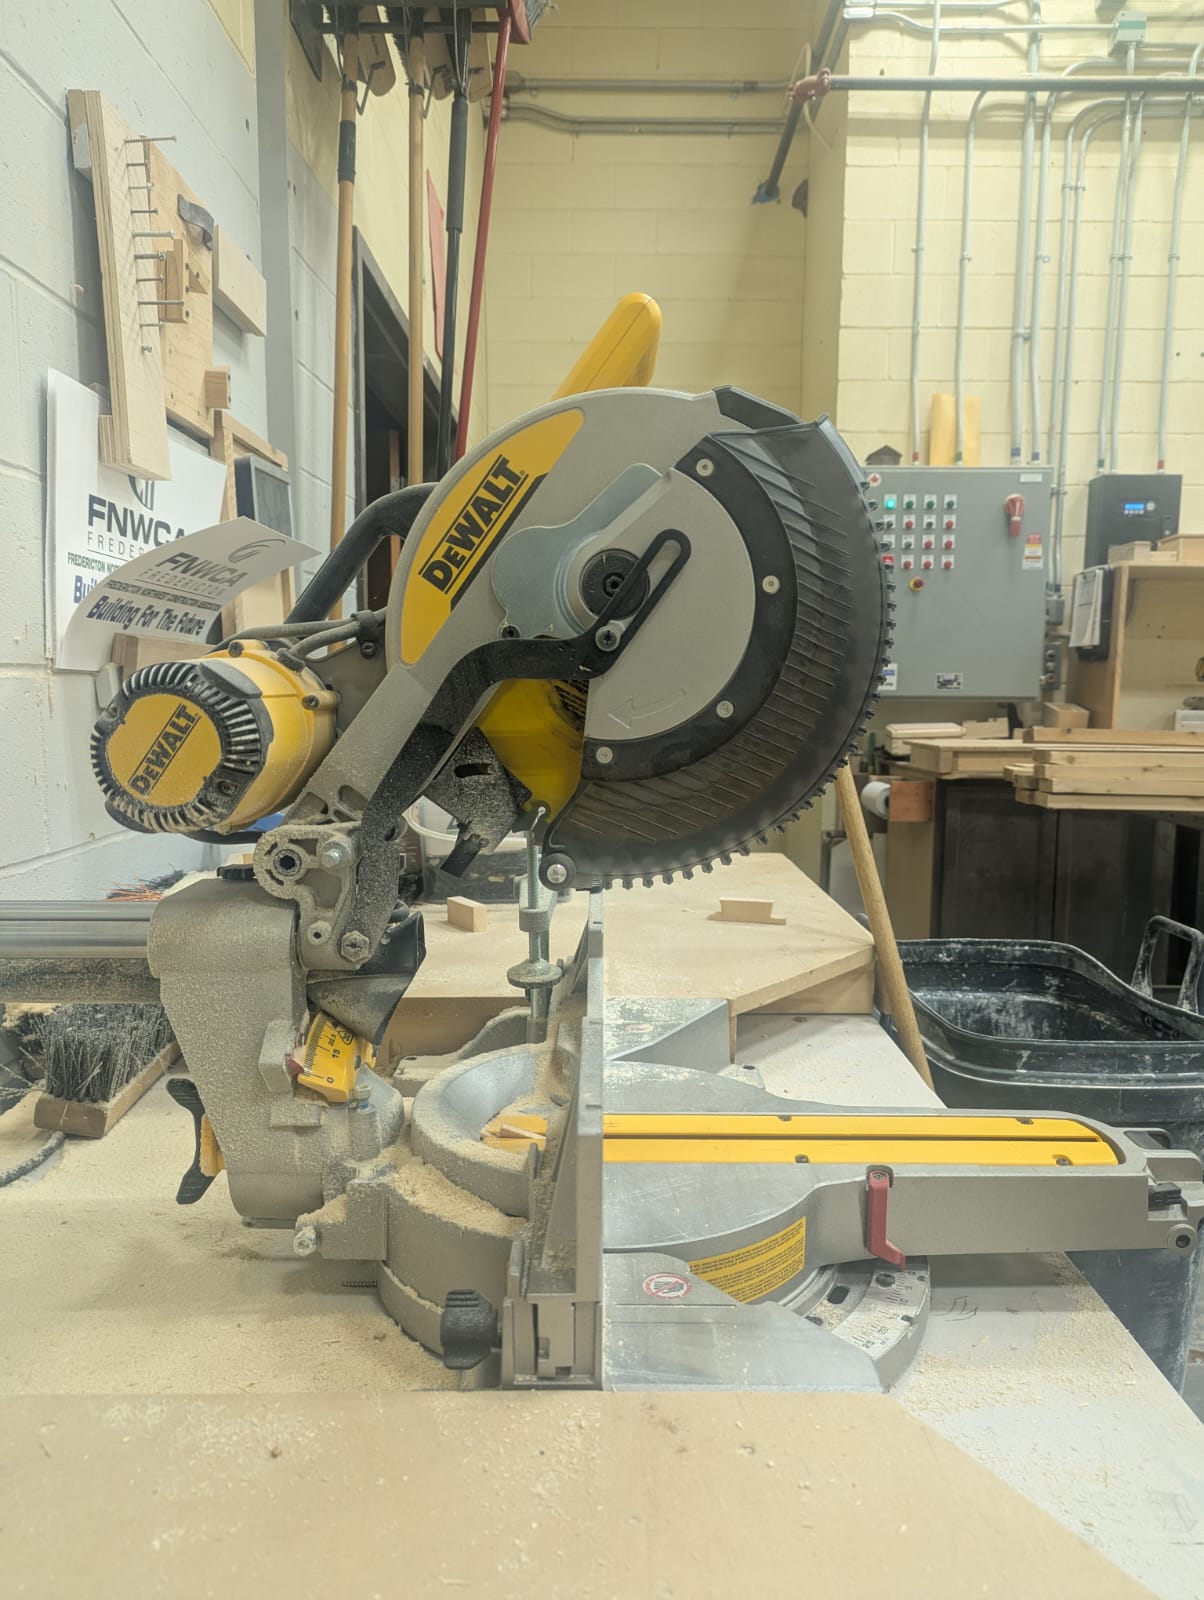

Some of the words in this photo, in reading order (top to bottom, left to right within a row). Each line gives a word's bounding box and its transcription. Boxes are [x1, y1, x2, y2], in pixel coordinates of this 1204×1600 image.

[421, 456, 522, 593] DEWALT
[67, 552, 106, 574] FREDERICTON
[155, 551, 249, 587] FNWCA
[86, 595, 141, 630] Building
[135, 604, 160, 628] For
[156, 608, 178, 631] The
[174, 612, 206, 636] Future
[130, 704, 198, 796] DEWALT
[332, 1048, 341, 1058] 15
